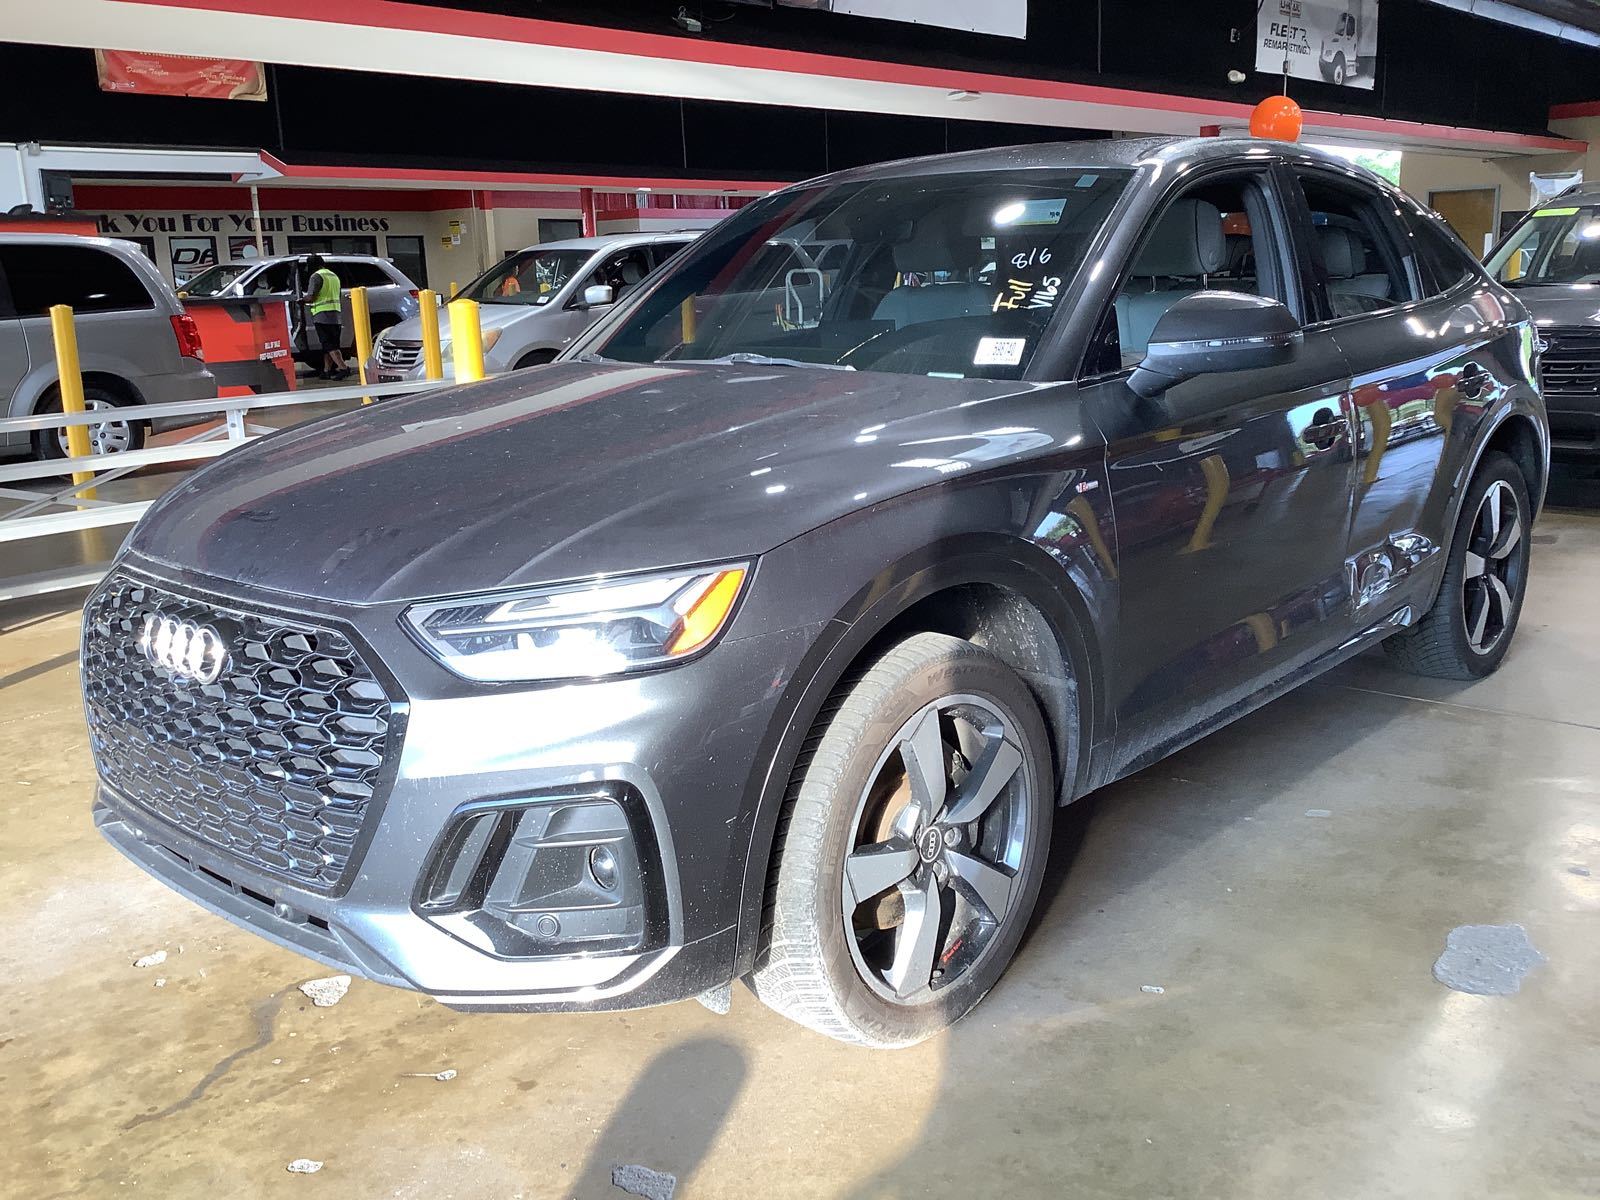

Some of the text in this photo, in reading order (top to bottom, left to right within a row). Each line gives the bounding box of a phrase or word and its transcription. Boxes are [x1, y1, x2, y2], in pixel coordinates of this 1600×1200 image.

[1263, 38, 1307, 55] REMARETING
[123, 214, 177, 233] You
[182, 213, 223, 232] For
[228, 214, 287, 232] Your
[291, 213, 390, 233] Business
[1011, 247, 1052, 269] 816
